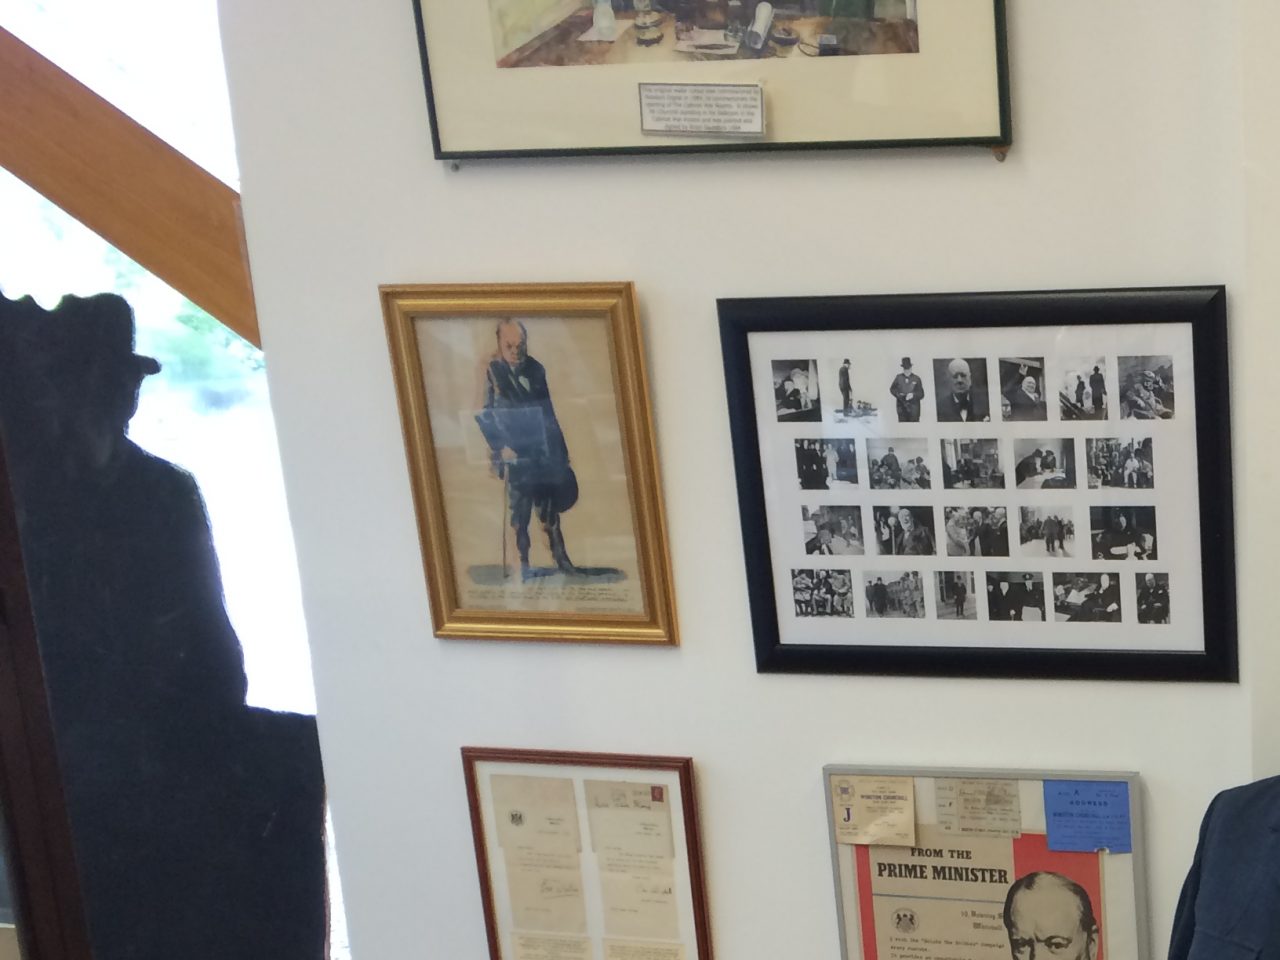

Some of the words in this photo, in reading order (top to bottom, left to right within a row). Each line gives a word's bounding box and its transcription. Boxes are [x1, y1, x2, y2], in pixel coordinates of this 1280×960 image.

[843, 808, 850, 822] J
[911, 848, 943, 858] FROM
[948, 850, 972, 860] THE
[877, 863, 928, 879] PRIME
[932, 866, 1008, 884] MINISTER
